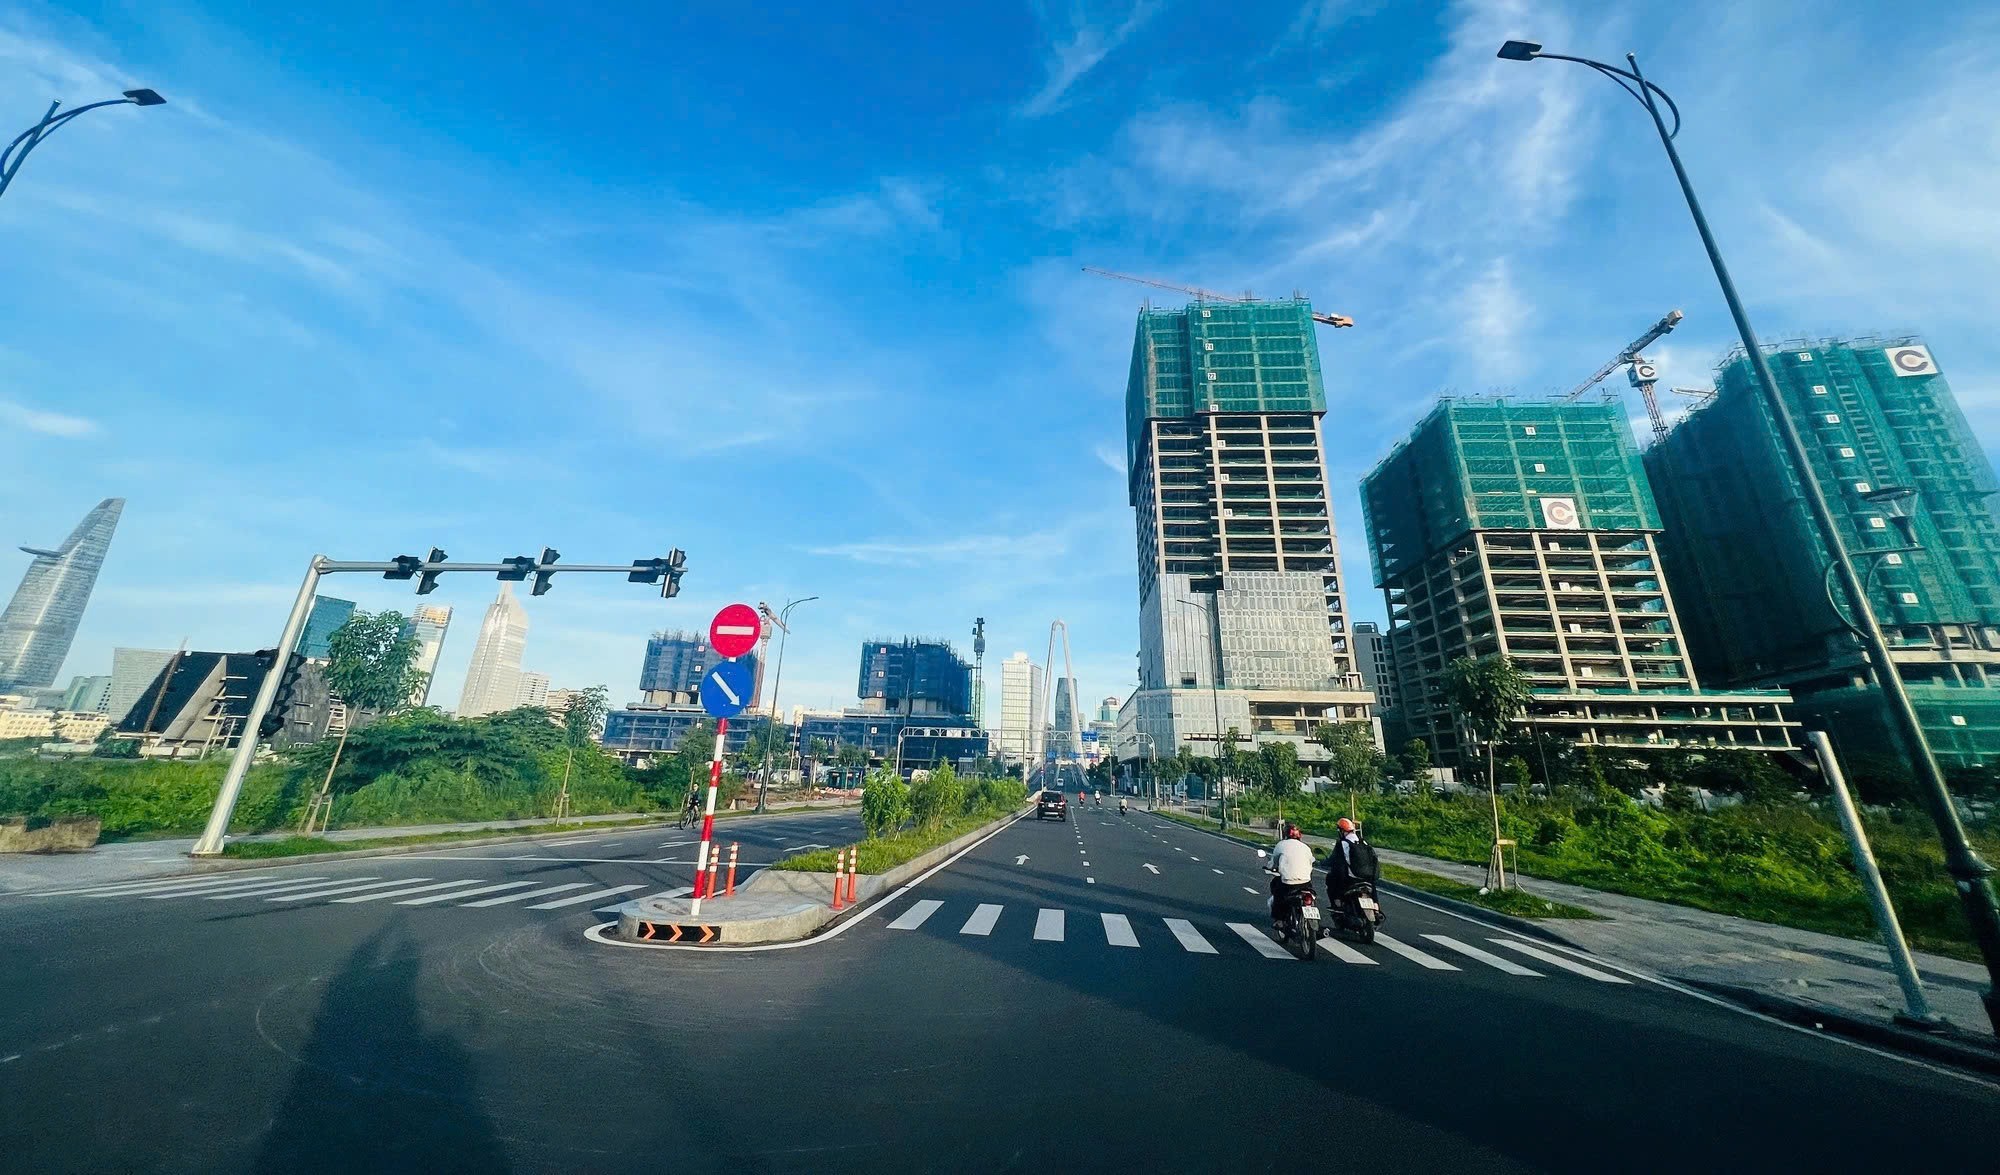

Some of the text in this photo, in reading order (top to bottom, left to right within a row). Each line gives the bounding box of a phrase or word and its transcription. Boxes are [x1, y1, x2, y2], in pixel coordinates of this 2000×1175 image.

[1639, 365, 1655, 377] C
[1895, 350, 1928, 372] C
[1547, 502, 1573, 525] C
